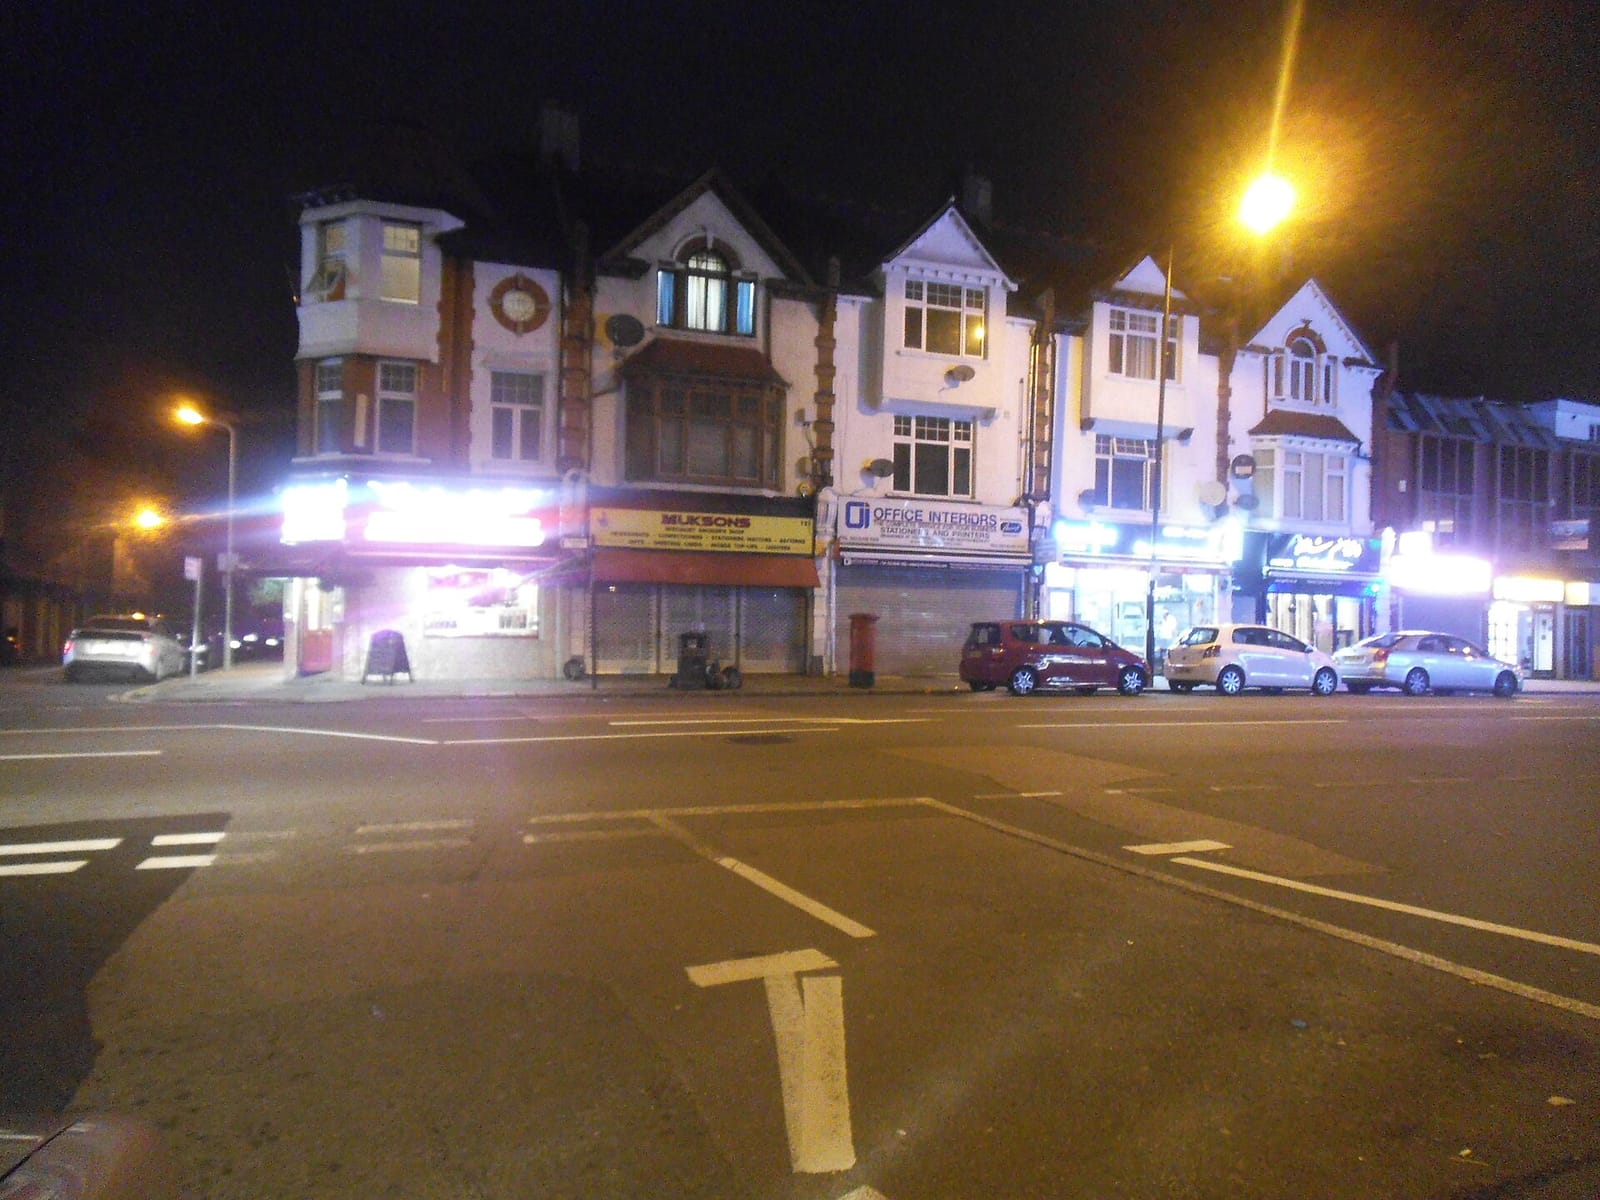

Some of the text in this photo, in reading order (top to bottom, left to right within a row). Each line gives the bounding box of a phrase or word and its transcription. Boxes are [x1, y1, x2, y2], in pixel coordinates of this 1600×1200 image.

[661, 513, 751, 528] MUKSONS
[874, 507, 923, 521] OFFICE
[929, 510, 998, 527] INTERIORS
[933, 529, 949, 537] AND
[952, 530, 990, 540] PRINTERS
